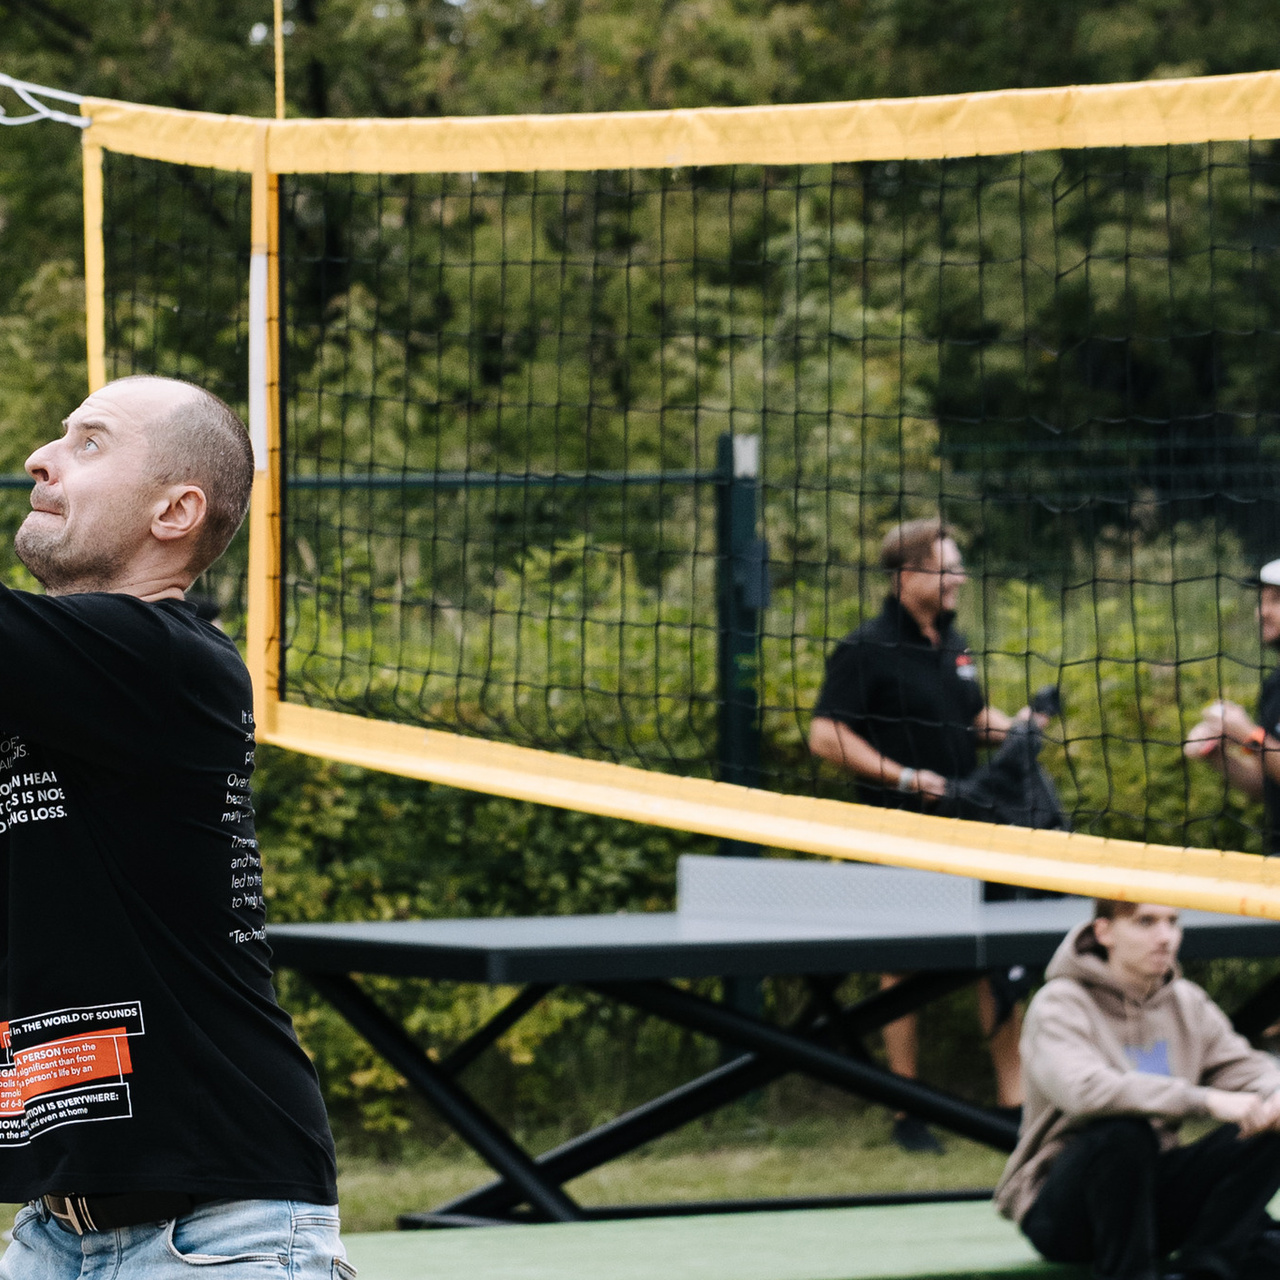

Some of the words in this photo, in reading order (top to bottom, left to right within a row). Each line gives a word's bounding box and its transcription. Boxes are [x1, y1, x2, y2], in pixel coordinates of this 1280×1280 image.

[21, 791, 35, 805] IS
[30, 805, 68, 821] LOSS.
[231, 872, 246, 889] led
[21, 1020, 42, 1033] THE
[42, 1013, 81, 1028] WORLD
[81, 1012, 95, 1022] OF
[95, 1007, 138, 1021] SOUNDS
[22, 1047, 61, 1064] PERSON
[62, 1045, 81, 1055] from
[76, 1054, 96, 1064] from
[0, 1099, 10, 1109] of
[56, 1091, 120, 1110] EVERYWHERE:
[5, 1130, 20, 1140] the
